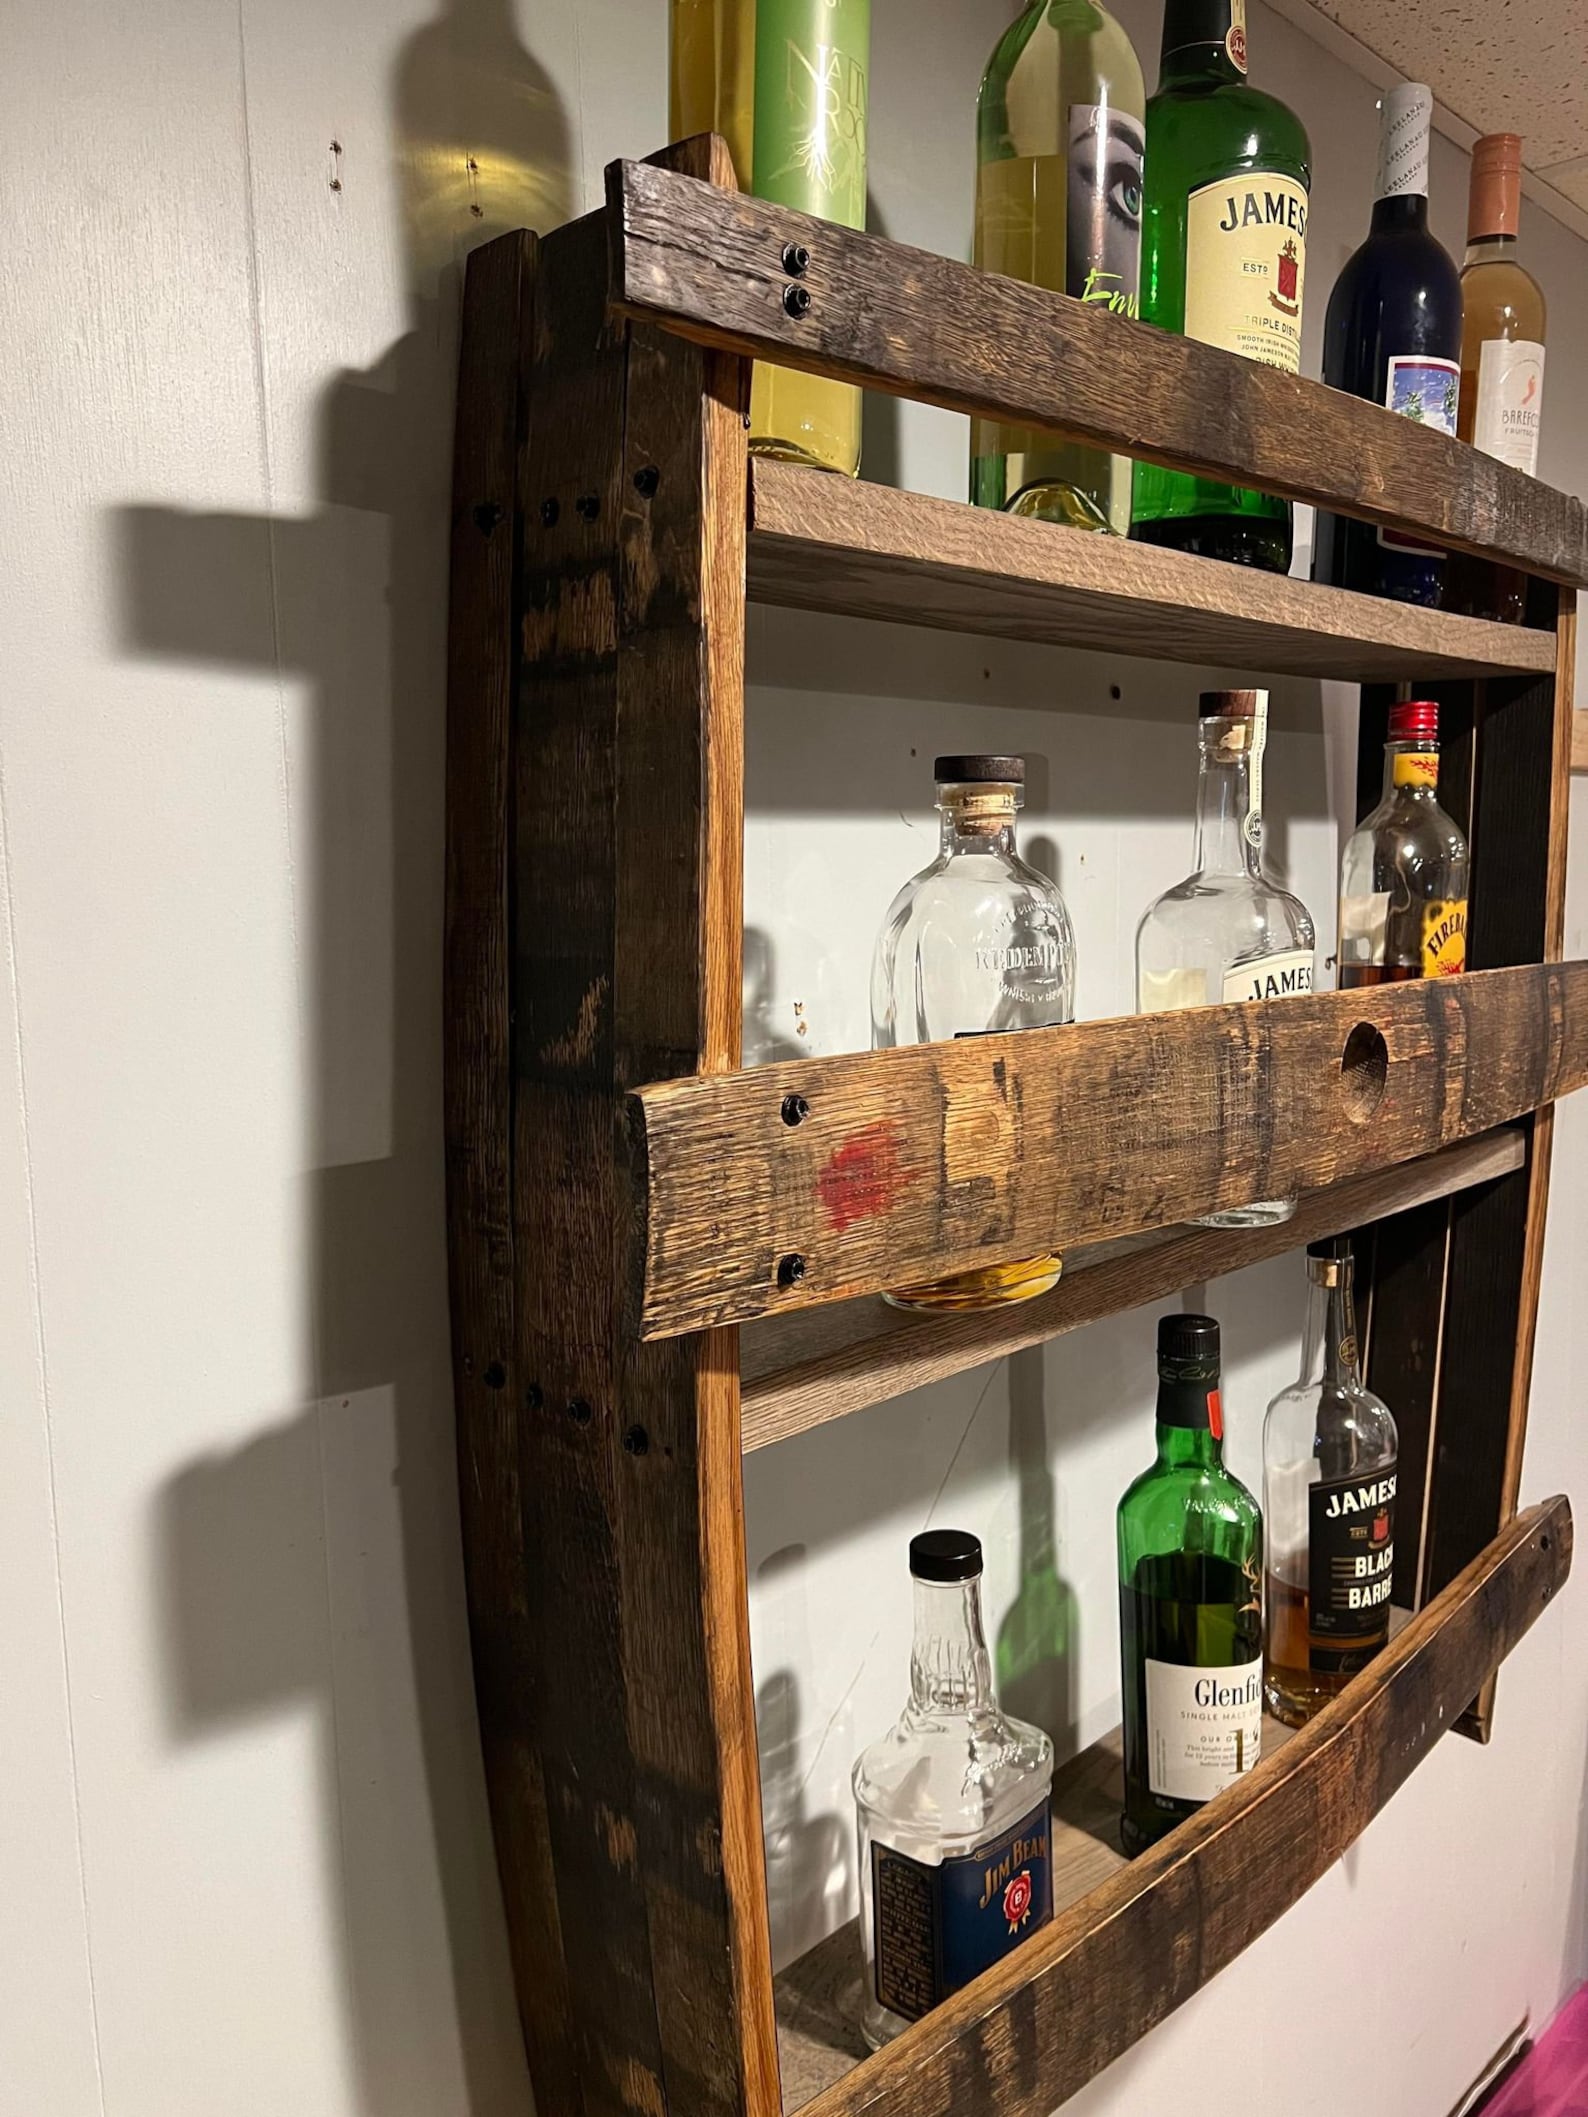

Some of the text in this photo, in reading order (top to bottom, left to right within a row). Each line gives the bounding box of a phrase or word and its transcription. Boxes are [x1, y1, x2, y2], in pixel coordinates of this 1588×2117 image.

[1220, 191, 1307, 237] JAMES
[1244, 314, 1279, 331] TRIPLE
[1236, 334, 1264, 343] SMOOTH
[1241, 344, 1258, 352] JOHN
[1248, 967, 1312, 1000] JAMES
[1349, 1573, 1393, 1610] BARRE
[1180, 1711, 1217, 1721] SINGLE
[1222, 1711, 1246, 1721] MALT
[1200, 1735, 1220, 1743] OUR
[979, 1855, 1010, 1910] JIM
[1012, 1834, 1047, 1872] BEAM
